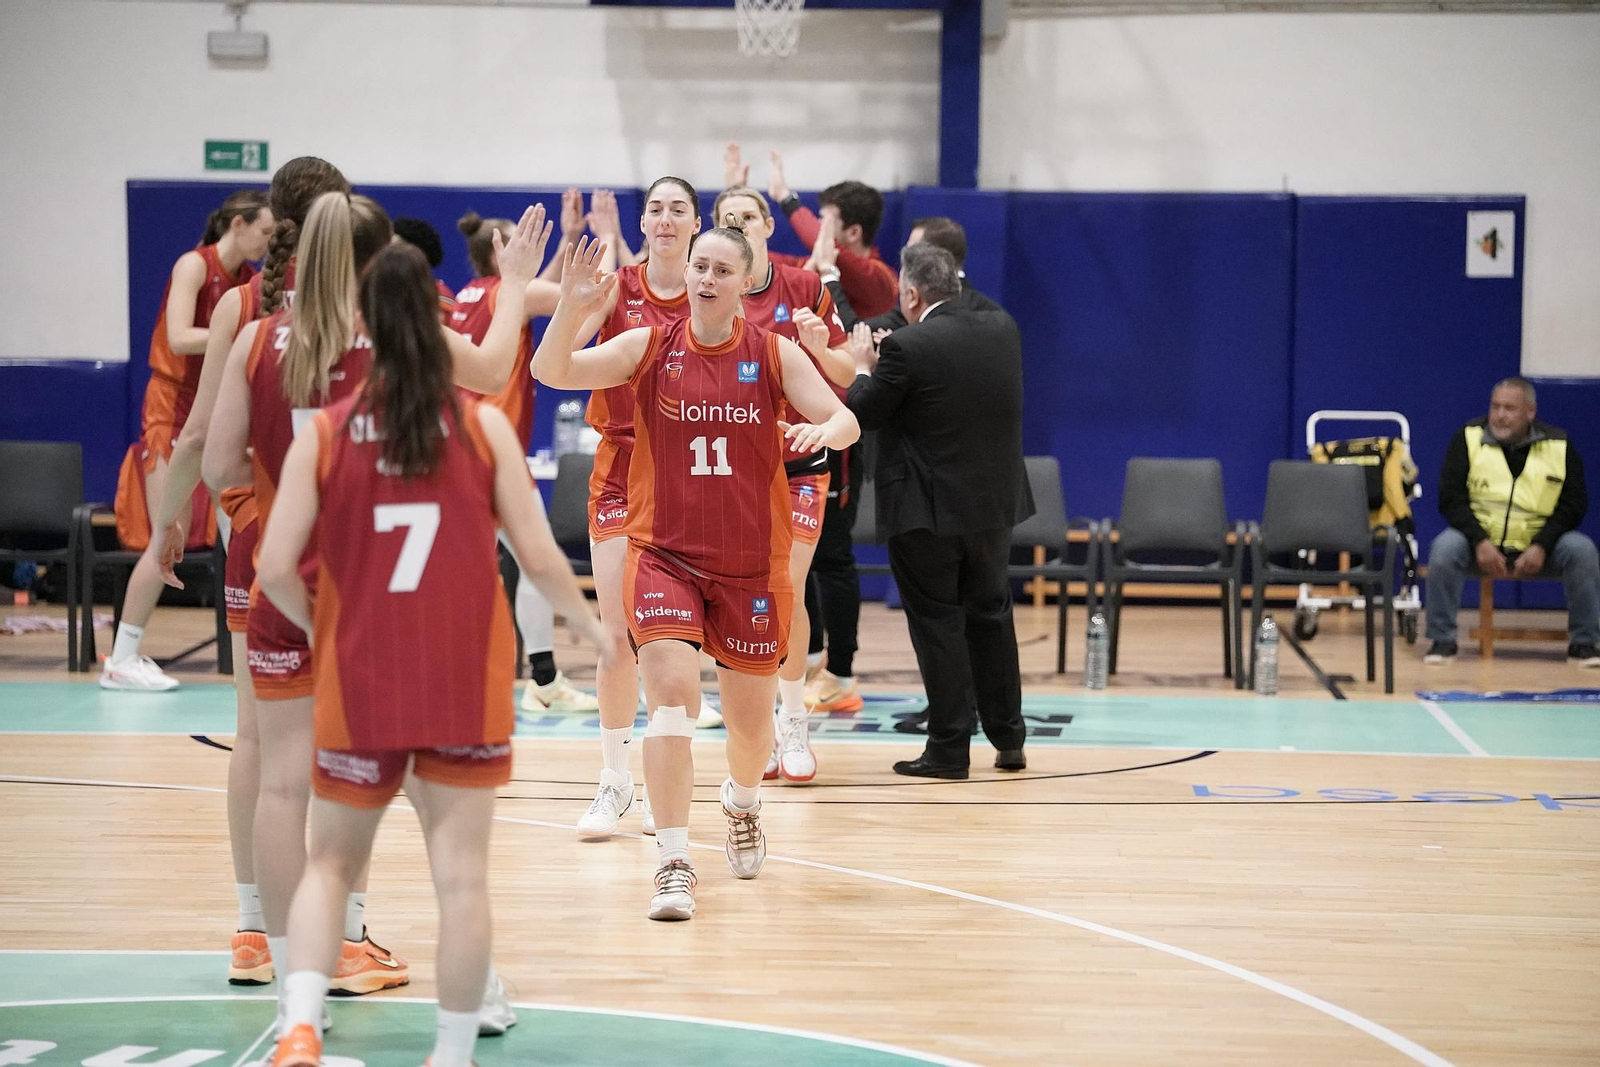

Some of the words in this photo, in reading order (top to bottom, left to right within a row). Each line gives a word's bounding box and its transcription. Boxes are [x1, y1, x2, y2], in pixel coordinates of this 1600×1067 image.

[680, 400, 761, 424] lointek
[689, 435, 733, 476] 11
[373, 502, 441, 593] 7
[642, 591, 665, 599] vive
[644, 606, 692, 618] sidenor
[726, 637, 777, 655] surne
